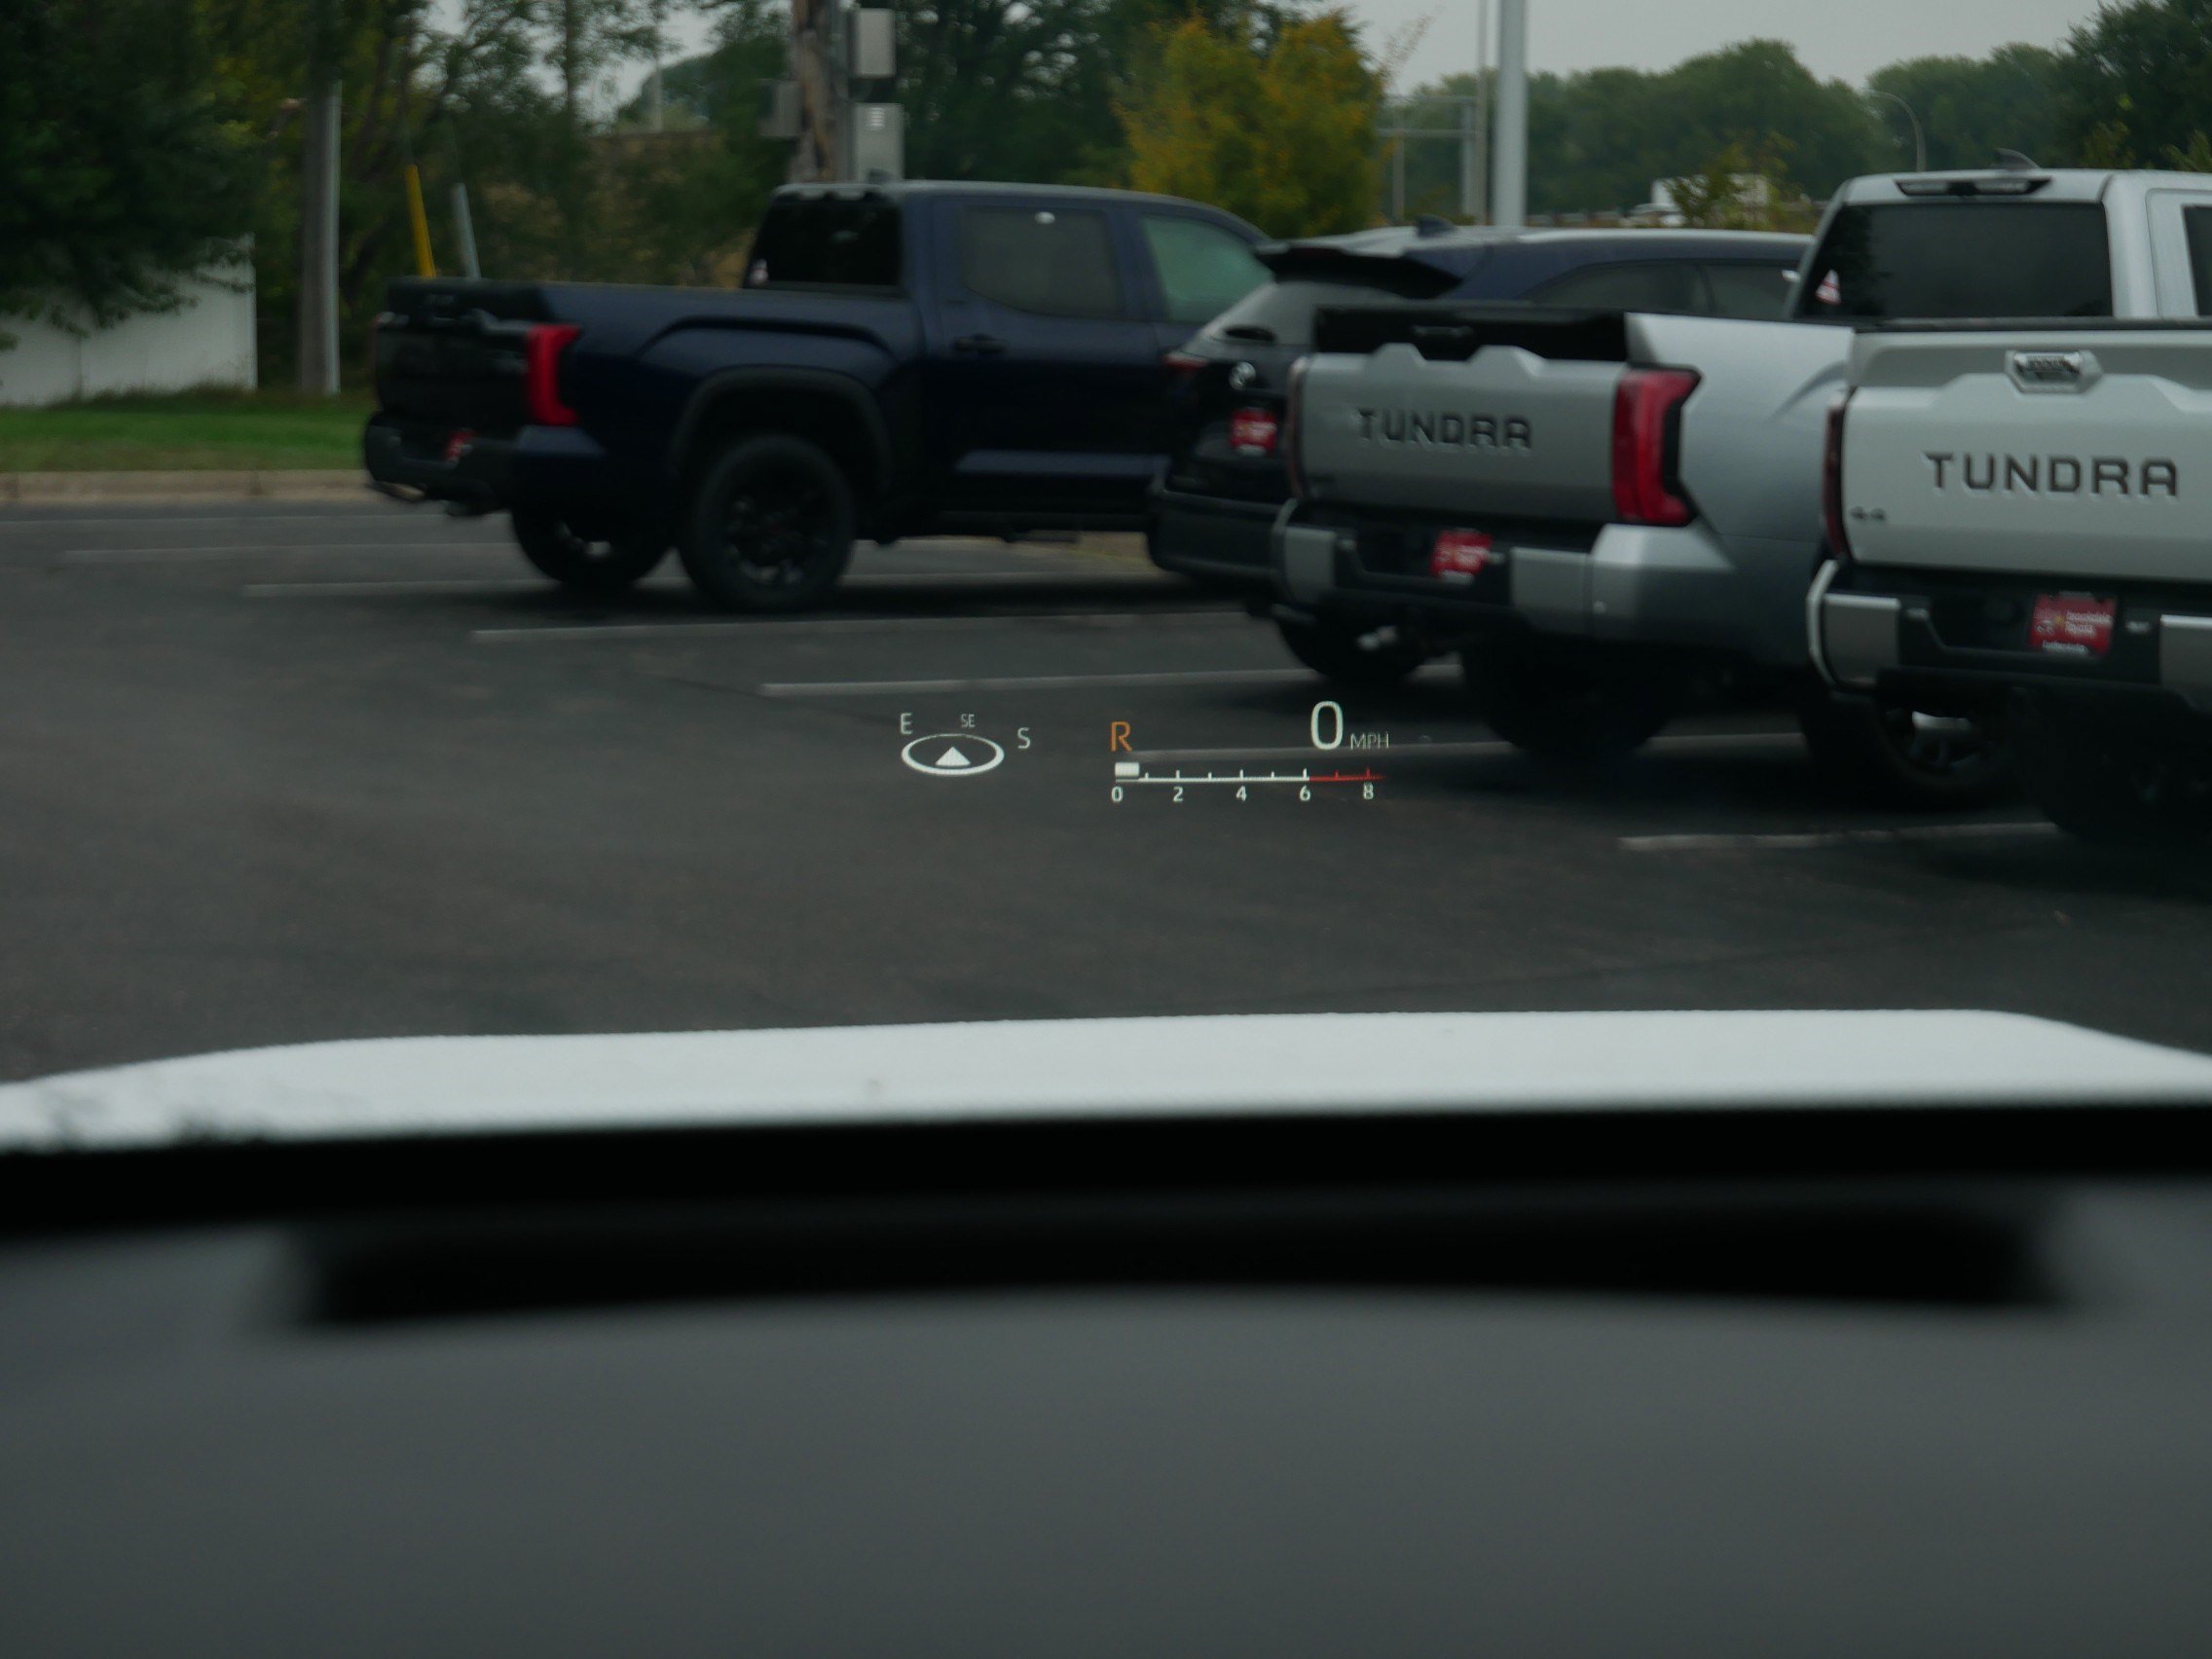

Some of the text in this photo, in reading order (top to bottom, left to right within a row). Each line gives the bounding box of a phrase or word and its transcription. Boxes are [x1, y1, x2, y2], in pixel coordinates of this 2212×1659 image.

[1358, 408, 1532, 449] TUNDRA
[1925, 452, 2177, 497] TUNDRA
[901, 713, 1031, 749] E SE S
[1111, 720, 1132, 752] R
[1310, 700, 1389, 750] 0 MPH
[1111, 782, 1374, 803] 0 2 4 6 8
